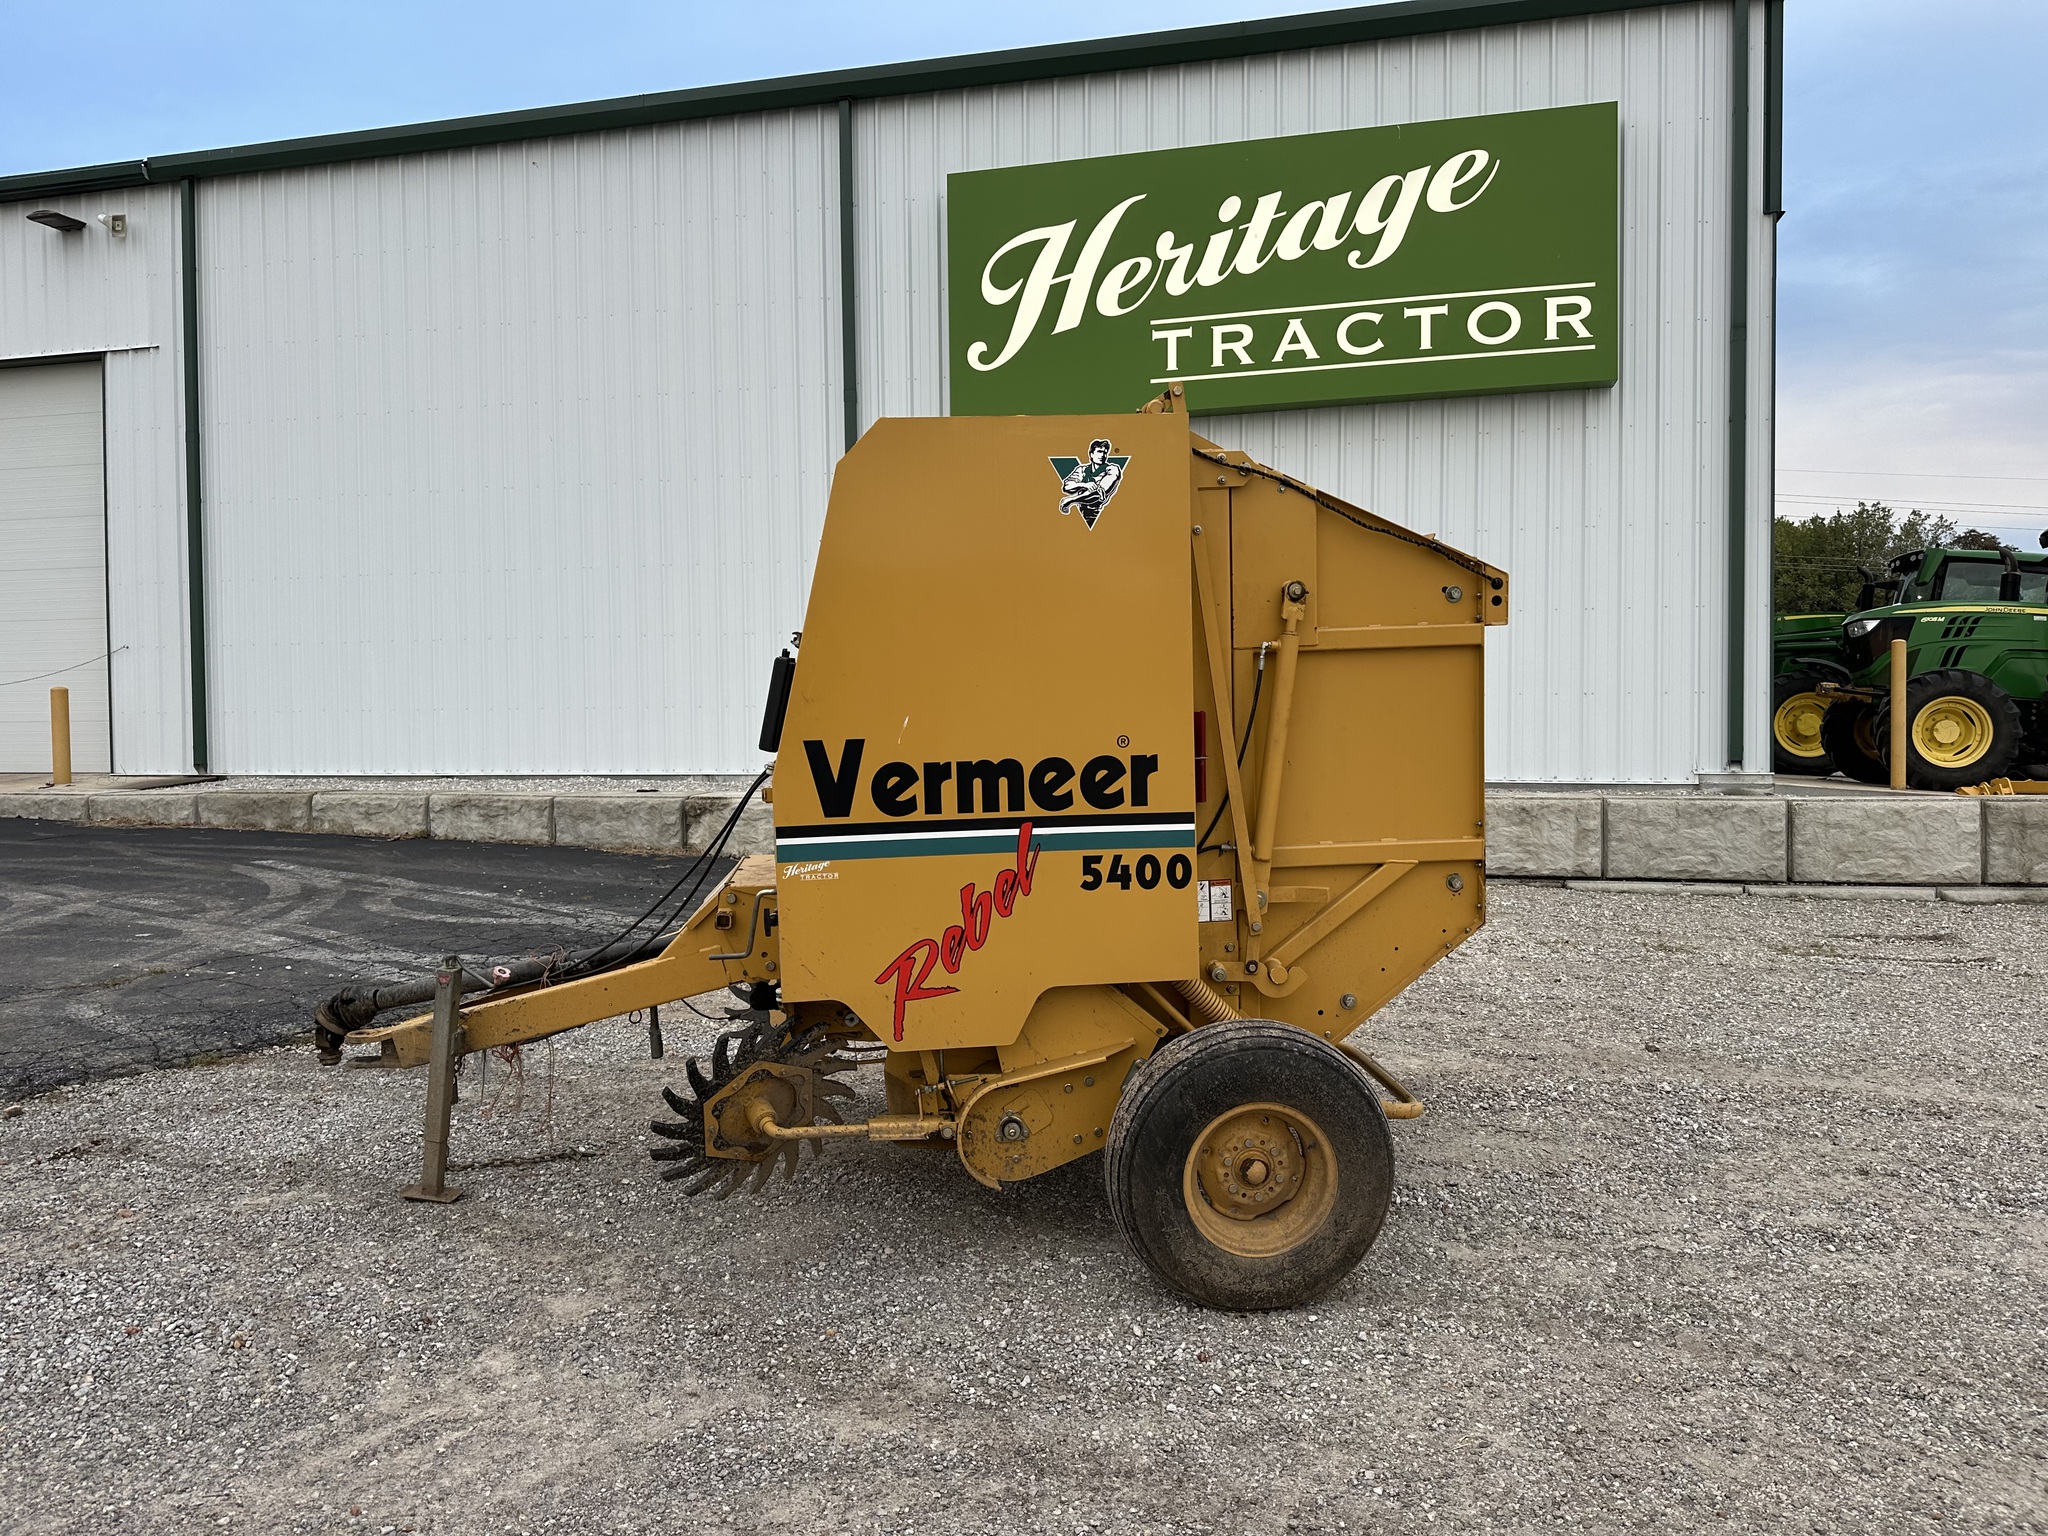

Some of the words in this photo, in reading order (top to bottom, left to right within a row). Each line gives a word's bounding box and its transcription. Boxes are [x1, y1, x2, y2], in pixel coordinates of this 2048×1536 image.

[966, 148, 1501, 373] Heritage
[1151, 294, 1595, 371] TRACTOR
[2003, 606, 2027, 614] DEERE
[782, 860, 831, 880] Heritage
[799, 872, 839, 881] TRACTOR
[1080, 853, 1193, 891] 5400
[874, 821, 1041, 1042] Rebel
